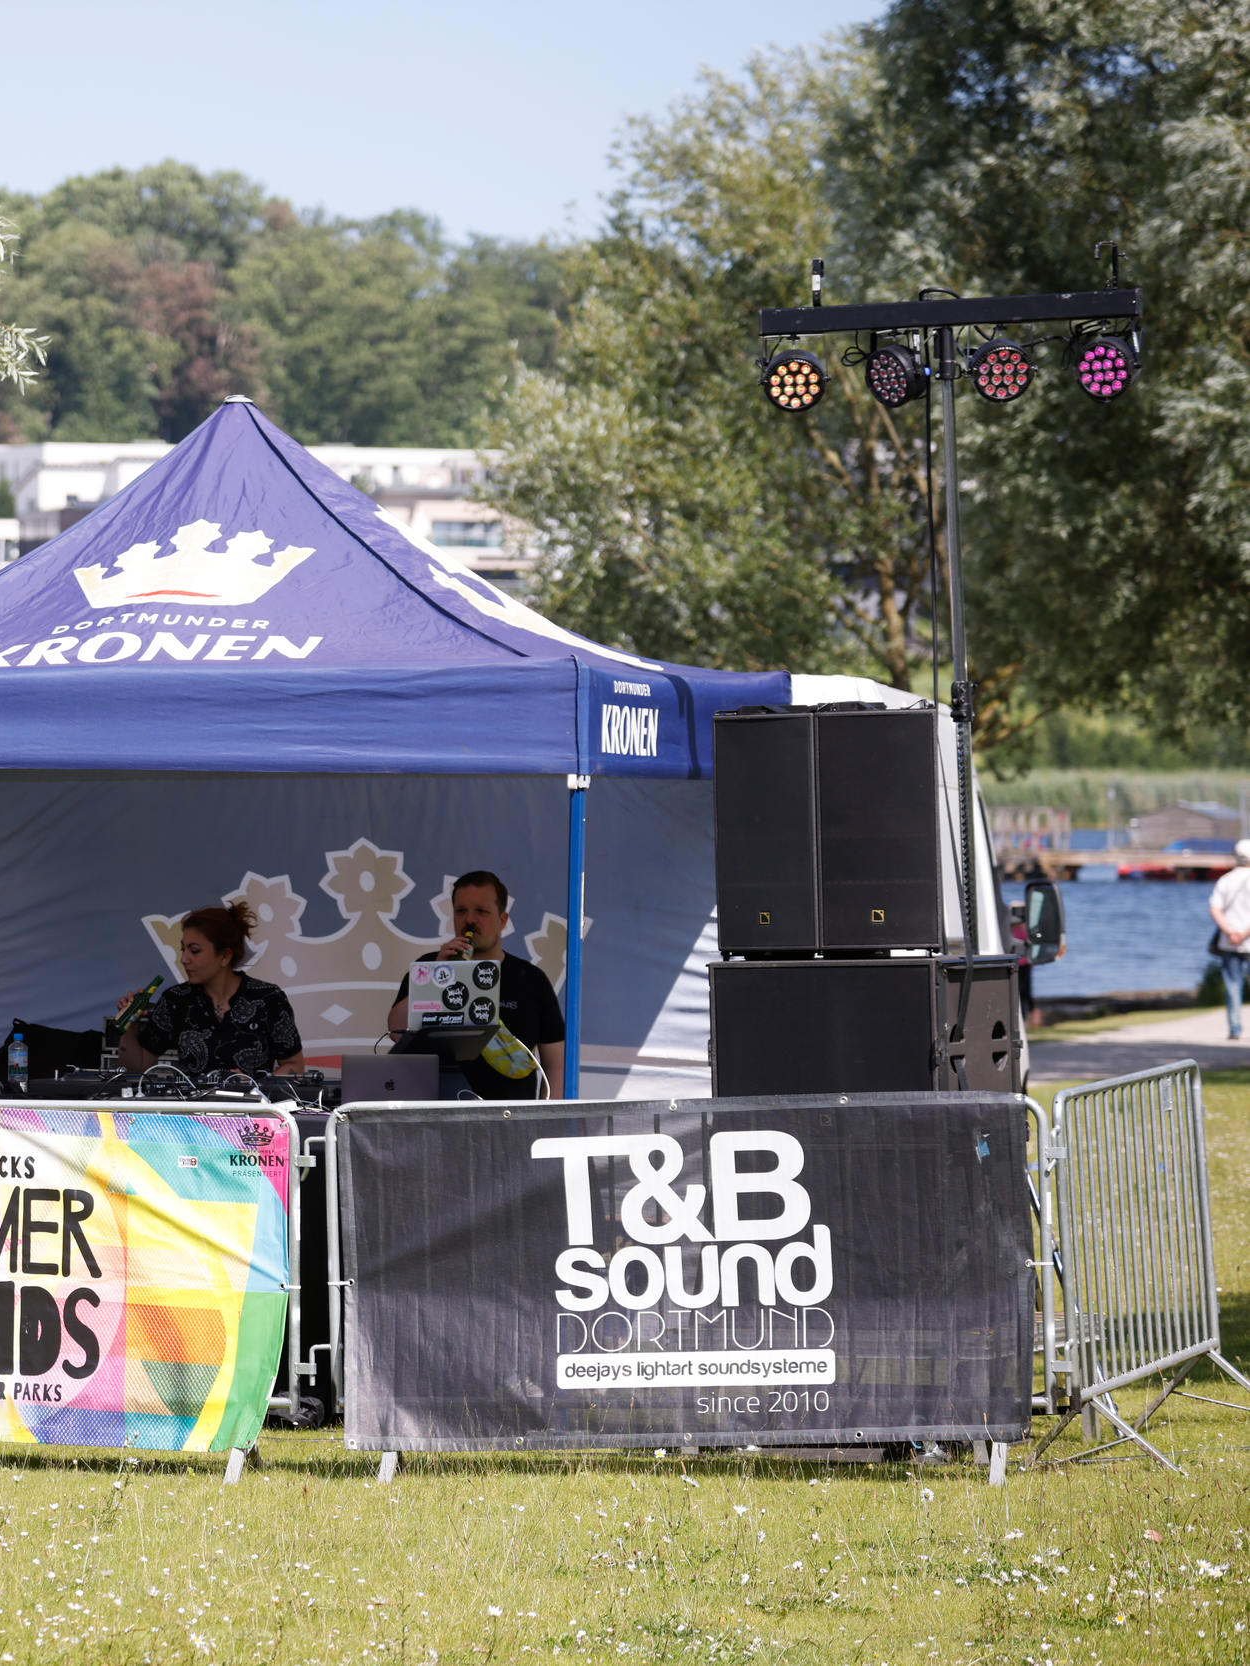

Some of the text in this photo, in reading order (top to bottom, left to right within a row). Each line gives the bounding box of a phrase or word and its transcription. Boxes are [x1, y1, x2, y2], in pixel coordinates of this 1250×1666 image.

[52, 612, 270, 635] DORTMUNDER
[614, 680, 651, 697] DORTMUNDER
[602, 704, 659, 757] KRONEN
[230, 1155, 285, 1167] KRONEN
[531, 1130, 812, 1246] T&B
[554, 1224, 832, 1311] sound
[557, 1307, 835, 1353] DORTMUND
[565, 1358, 828, 1381] deejays lightart soundsysteme
[14, 1382, 62, 1402] PARKS
[697, 1390, 830, 1413] since 2010
